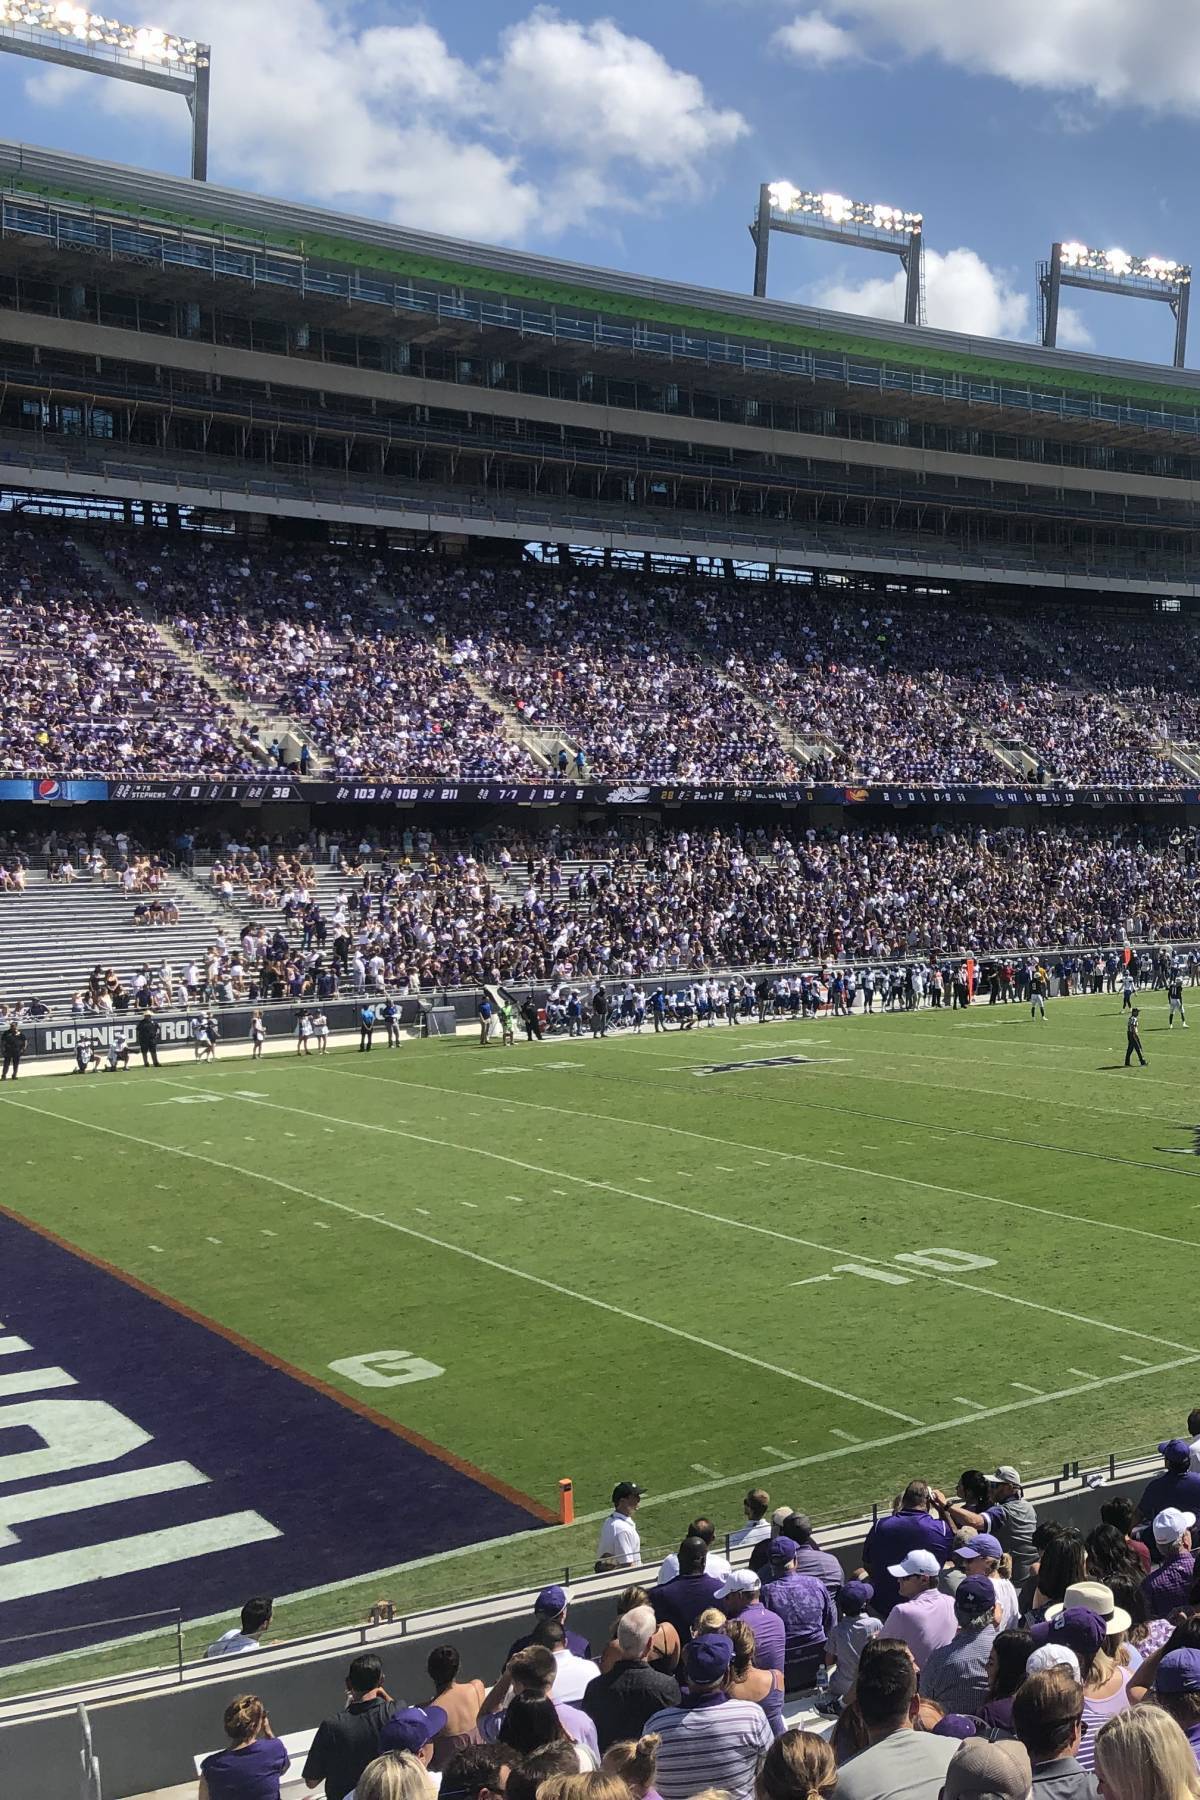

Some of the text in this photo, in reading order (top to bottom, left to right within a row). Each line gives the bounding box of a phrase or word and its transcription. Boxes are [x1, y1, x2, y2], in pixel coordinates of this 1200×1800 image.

[231, 787, 238, 798] 1
[271, 787, 290, 798] 38
[354, 788, 376, 800] 103
[397, 788, 418, 800] 108
[440, 789, 458, 800] 211
[499, 789, 517, 799] 7/7
[544, 789, 554, 799] 19
[661, 791, 674, 800] 28
[715, 792, 724, 800] 12
[735, 789, 752, 798] 6:33
[775, 792, 787, 801] 44
[1008, 793, 1017, 802] 41
[1065, 793, 1074, 802] 13
[46, 1024, 137, 1051] HORNED
[833, 1247, 999, 1286] 10
[327, 1349, 446, 1388] G
